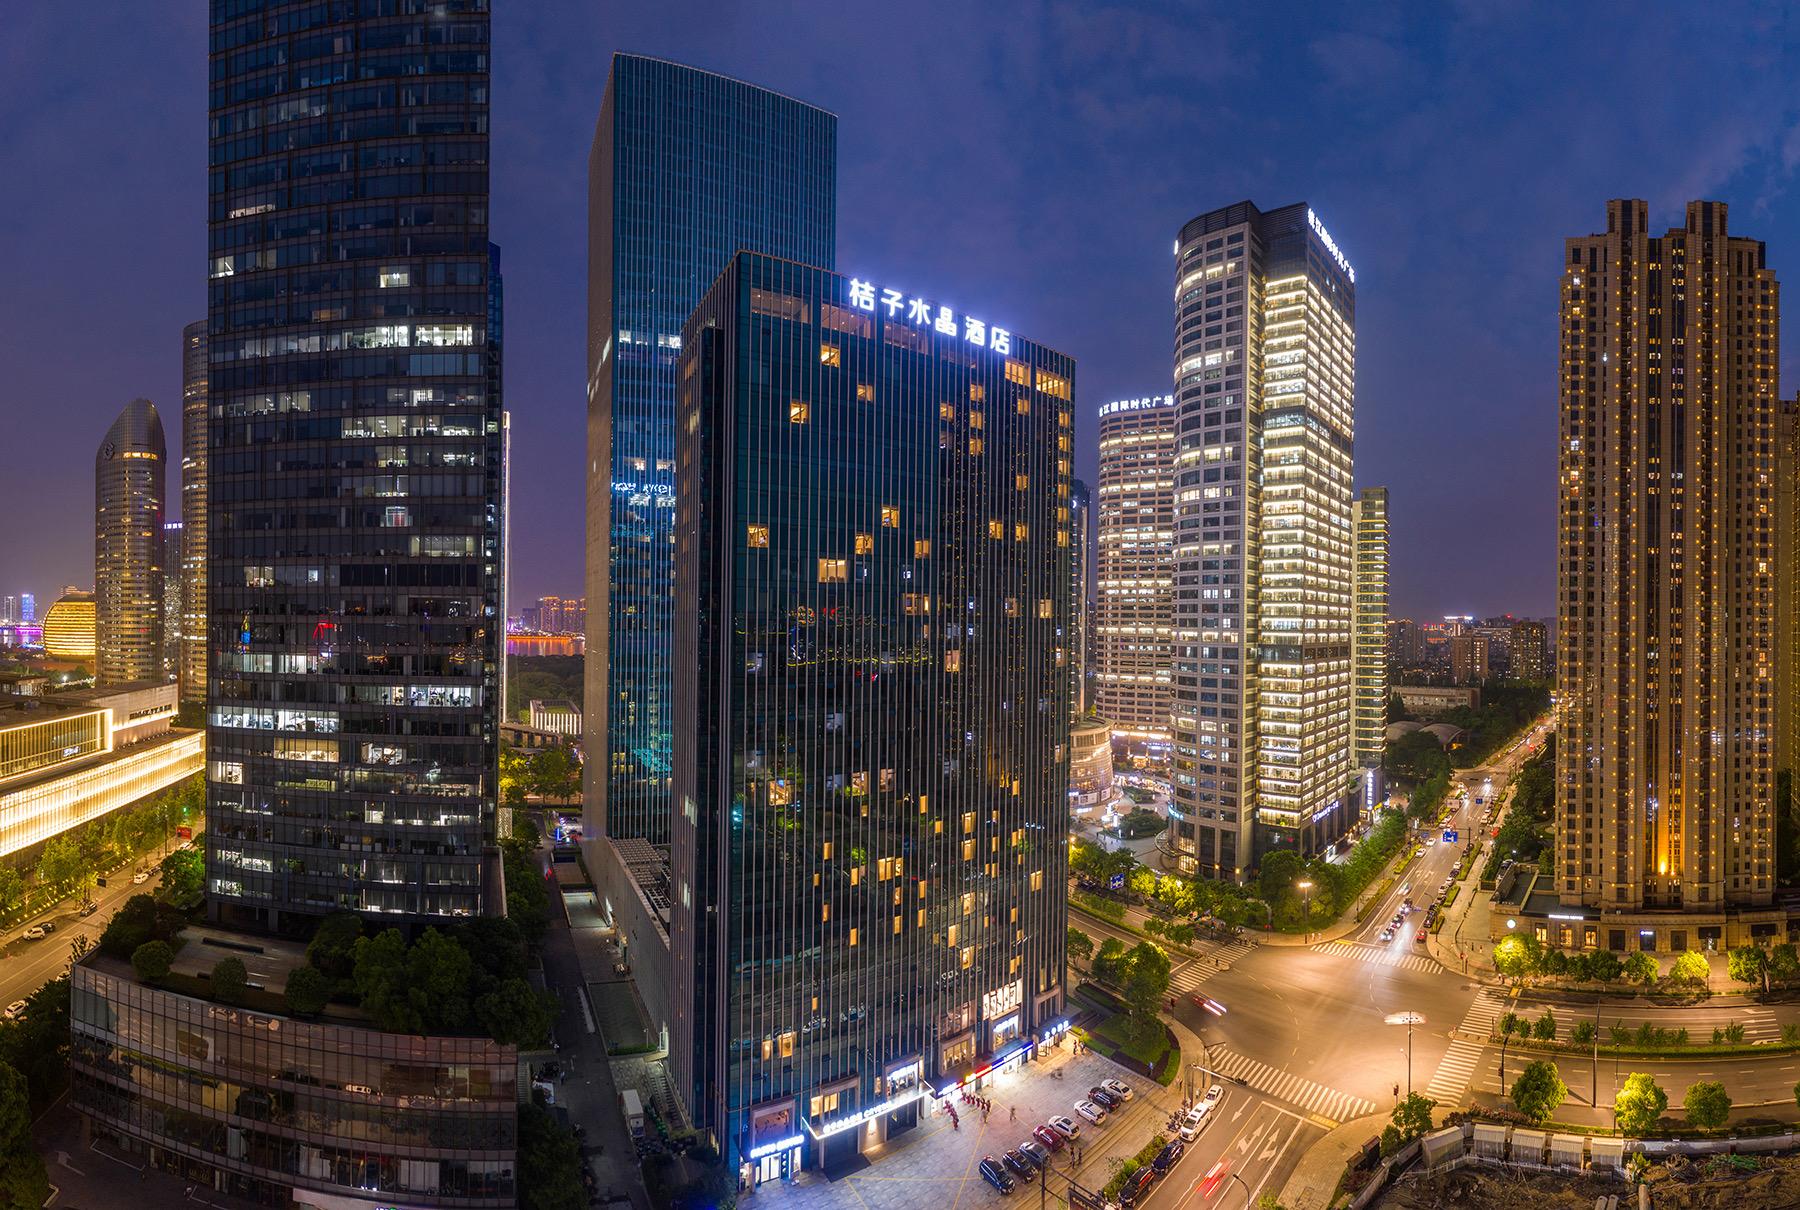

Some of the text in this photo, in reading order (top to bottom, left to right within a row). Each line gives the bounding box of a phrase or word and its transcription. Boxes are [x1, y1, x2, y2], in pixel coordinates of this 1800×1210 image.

[848, 278, 1011, 356] 桔子水晶酒店
